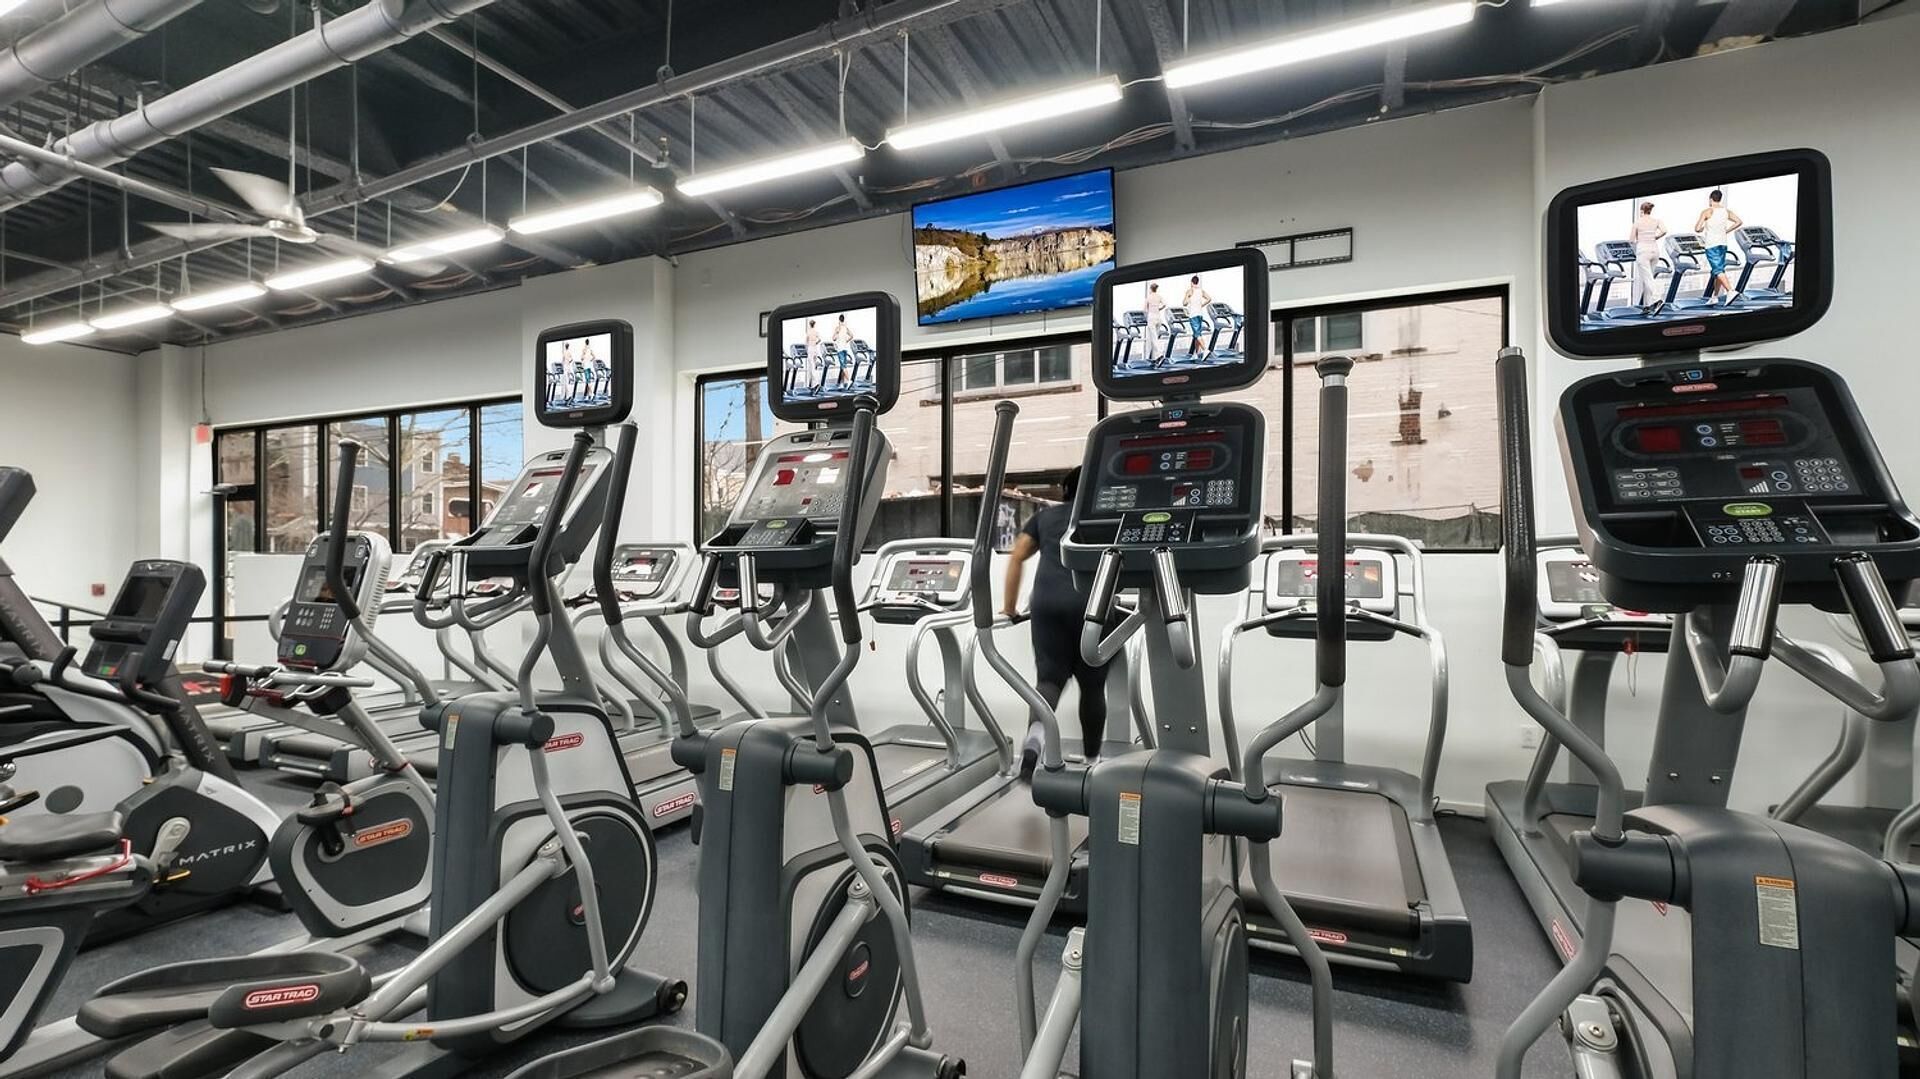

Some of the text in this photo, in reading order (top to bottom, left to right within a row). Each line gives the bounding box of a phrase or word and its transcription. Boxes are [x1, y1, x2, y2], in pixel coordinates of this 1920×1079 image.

[179, 840, 256, 866] MATRIX
[249, 989, 315, 1004] STAR TRAC
